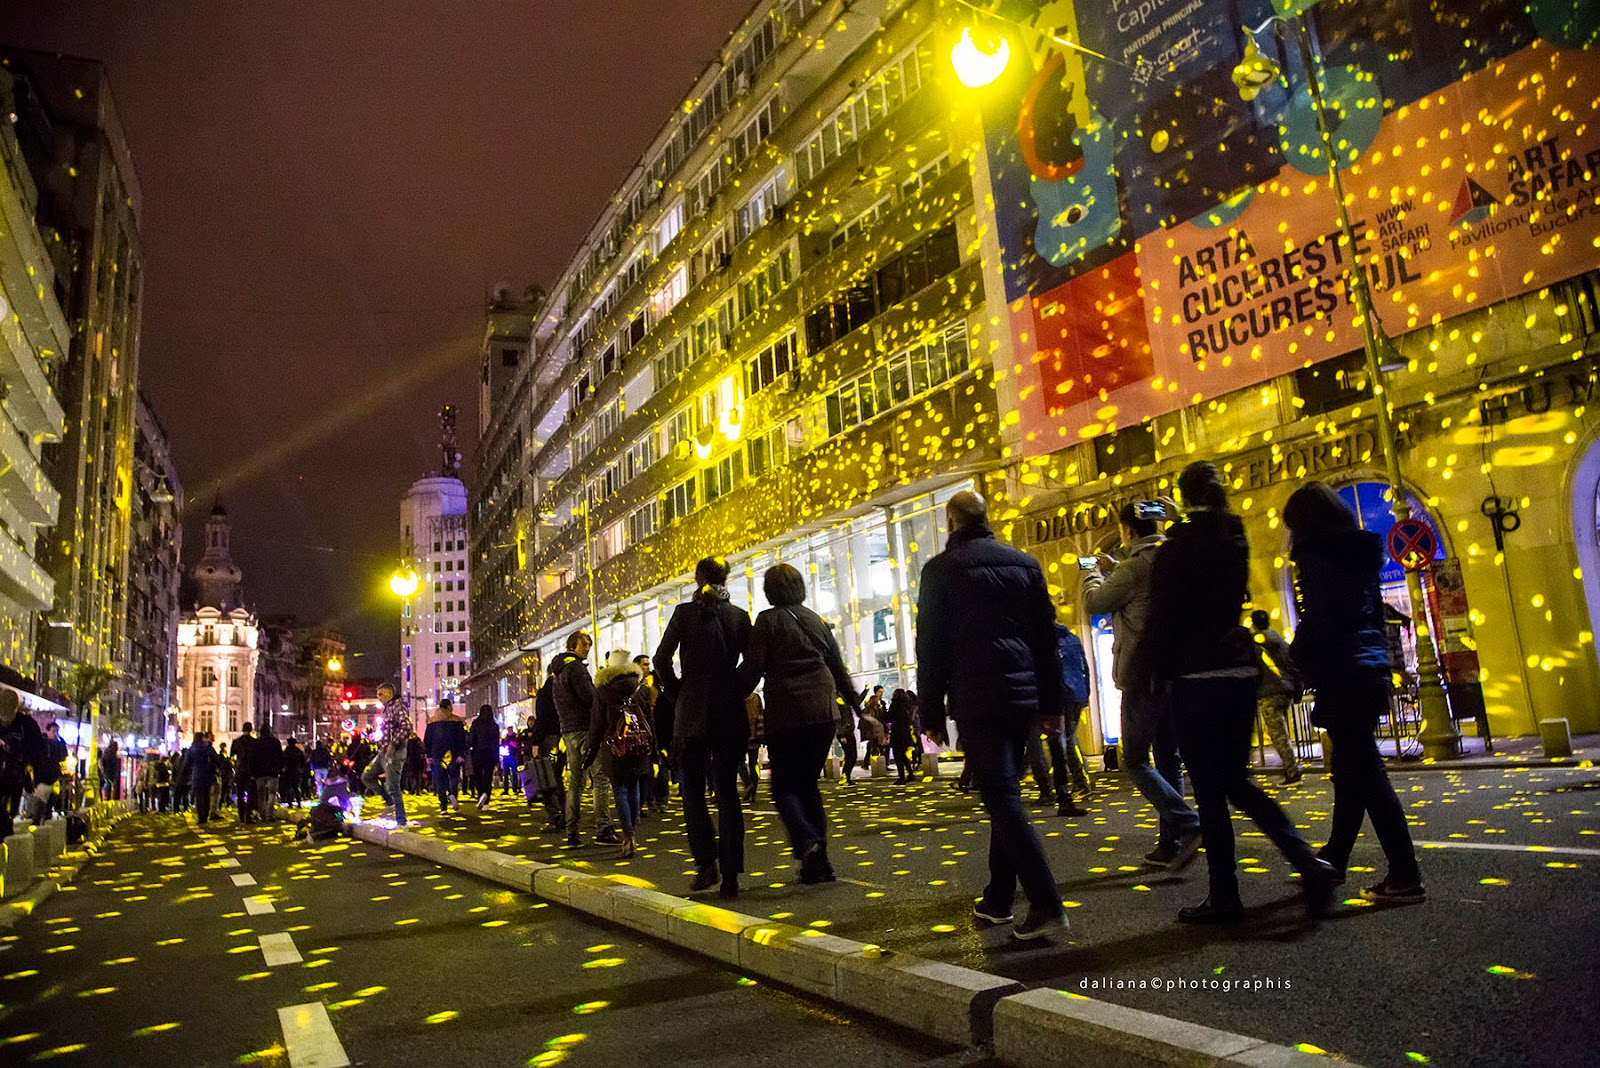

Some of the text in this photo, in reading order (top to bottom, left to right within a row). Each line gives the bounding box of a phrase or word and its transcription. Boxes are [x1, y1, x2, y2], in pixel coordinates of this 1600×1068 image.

[1123, 25, 1162, 58] PARTENER
[1162, 0, 1204, 31] PRINCIPAL
[1508, 136, 1560, 180] ART
[1379, 221, 1404, 239] ART
[1381, 223, 1430, 253] SAFARI
[1450, 206, 1536, 250] Pavilionul
[1544, 199, 1569, 215] de
[1179, 230, 1257, 288] ARTA
